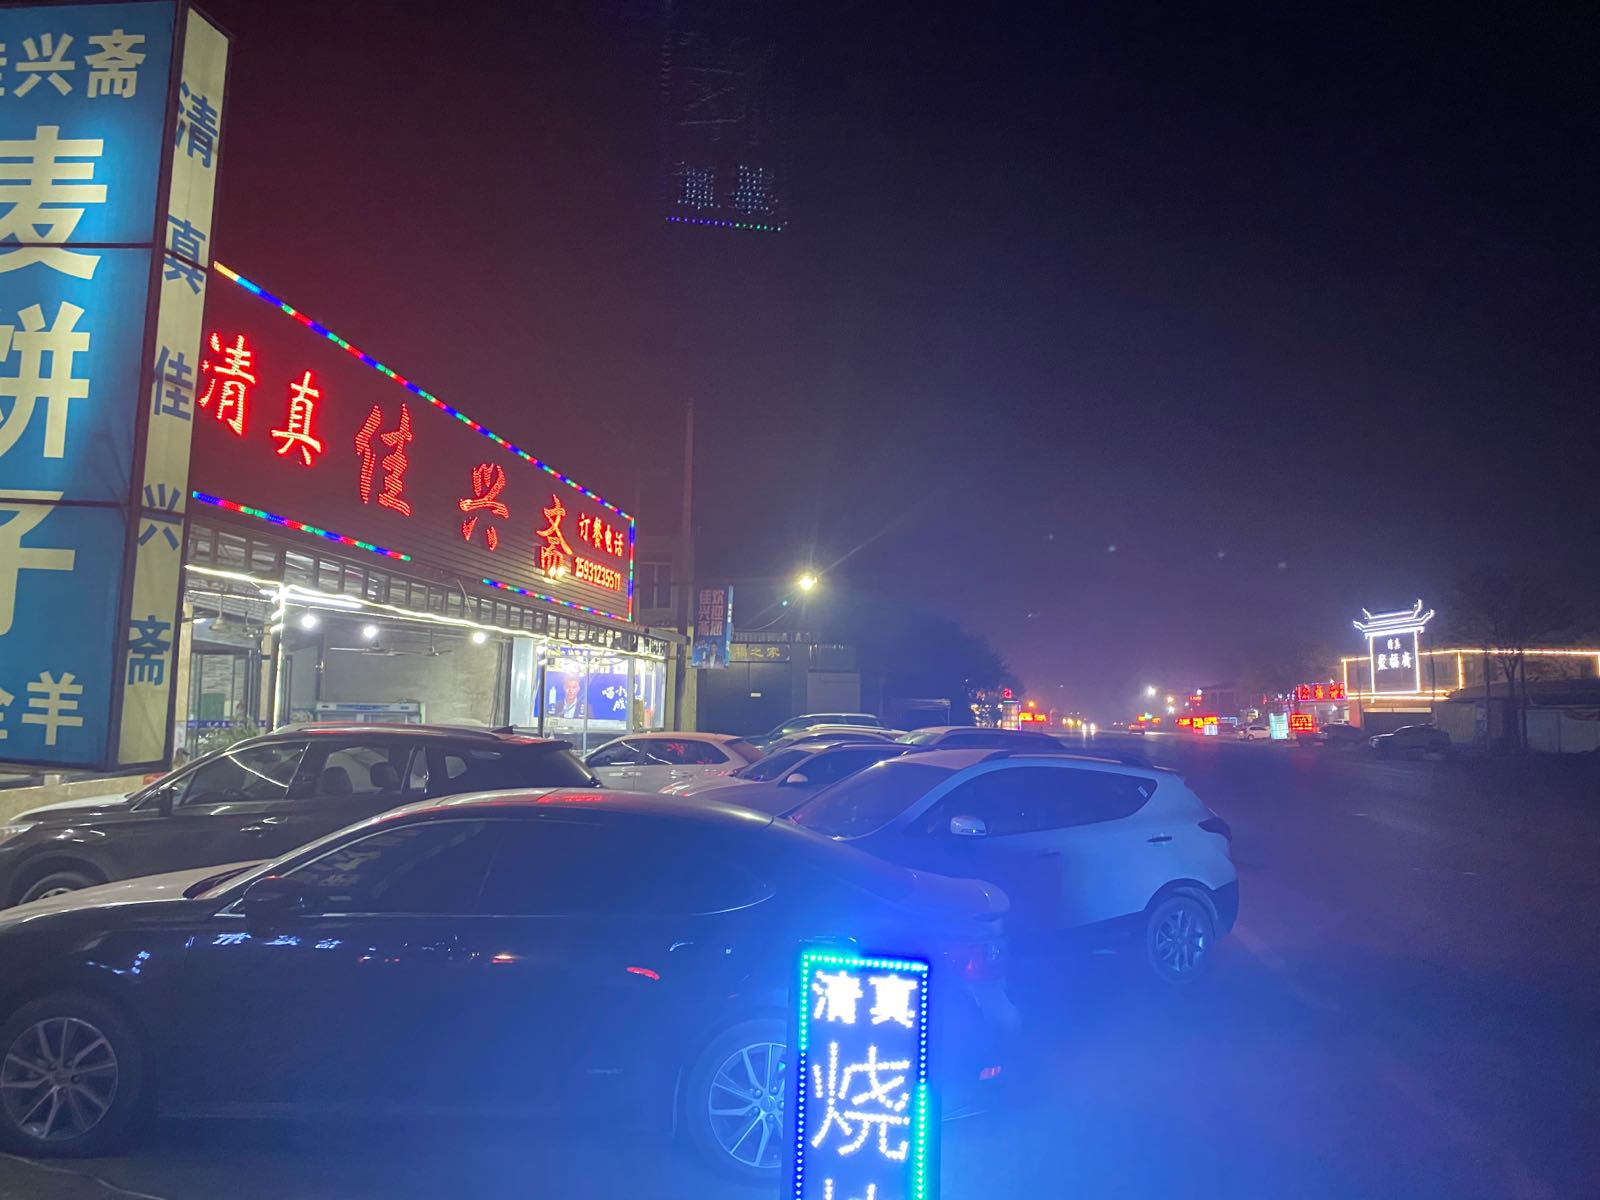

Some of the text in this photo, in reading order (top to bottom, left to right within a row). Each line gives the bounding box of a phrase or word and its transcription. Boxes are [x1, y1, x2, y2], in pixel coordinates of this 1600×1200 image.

[128, 81, 218, 686] 清真佳兴斋
[199, 332, 574, 582] 清真佳兴斋
[579, 512, 623, 557] 订餐电话
[575, 556, 621, 591] 15931235511
[0, 671, 83, 746] 羊
[812, 970, 918, 1029] 清真
[810, 1041, 911, 1200] 烧
